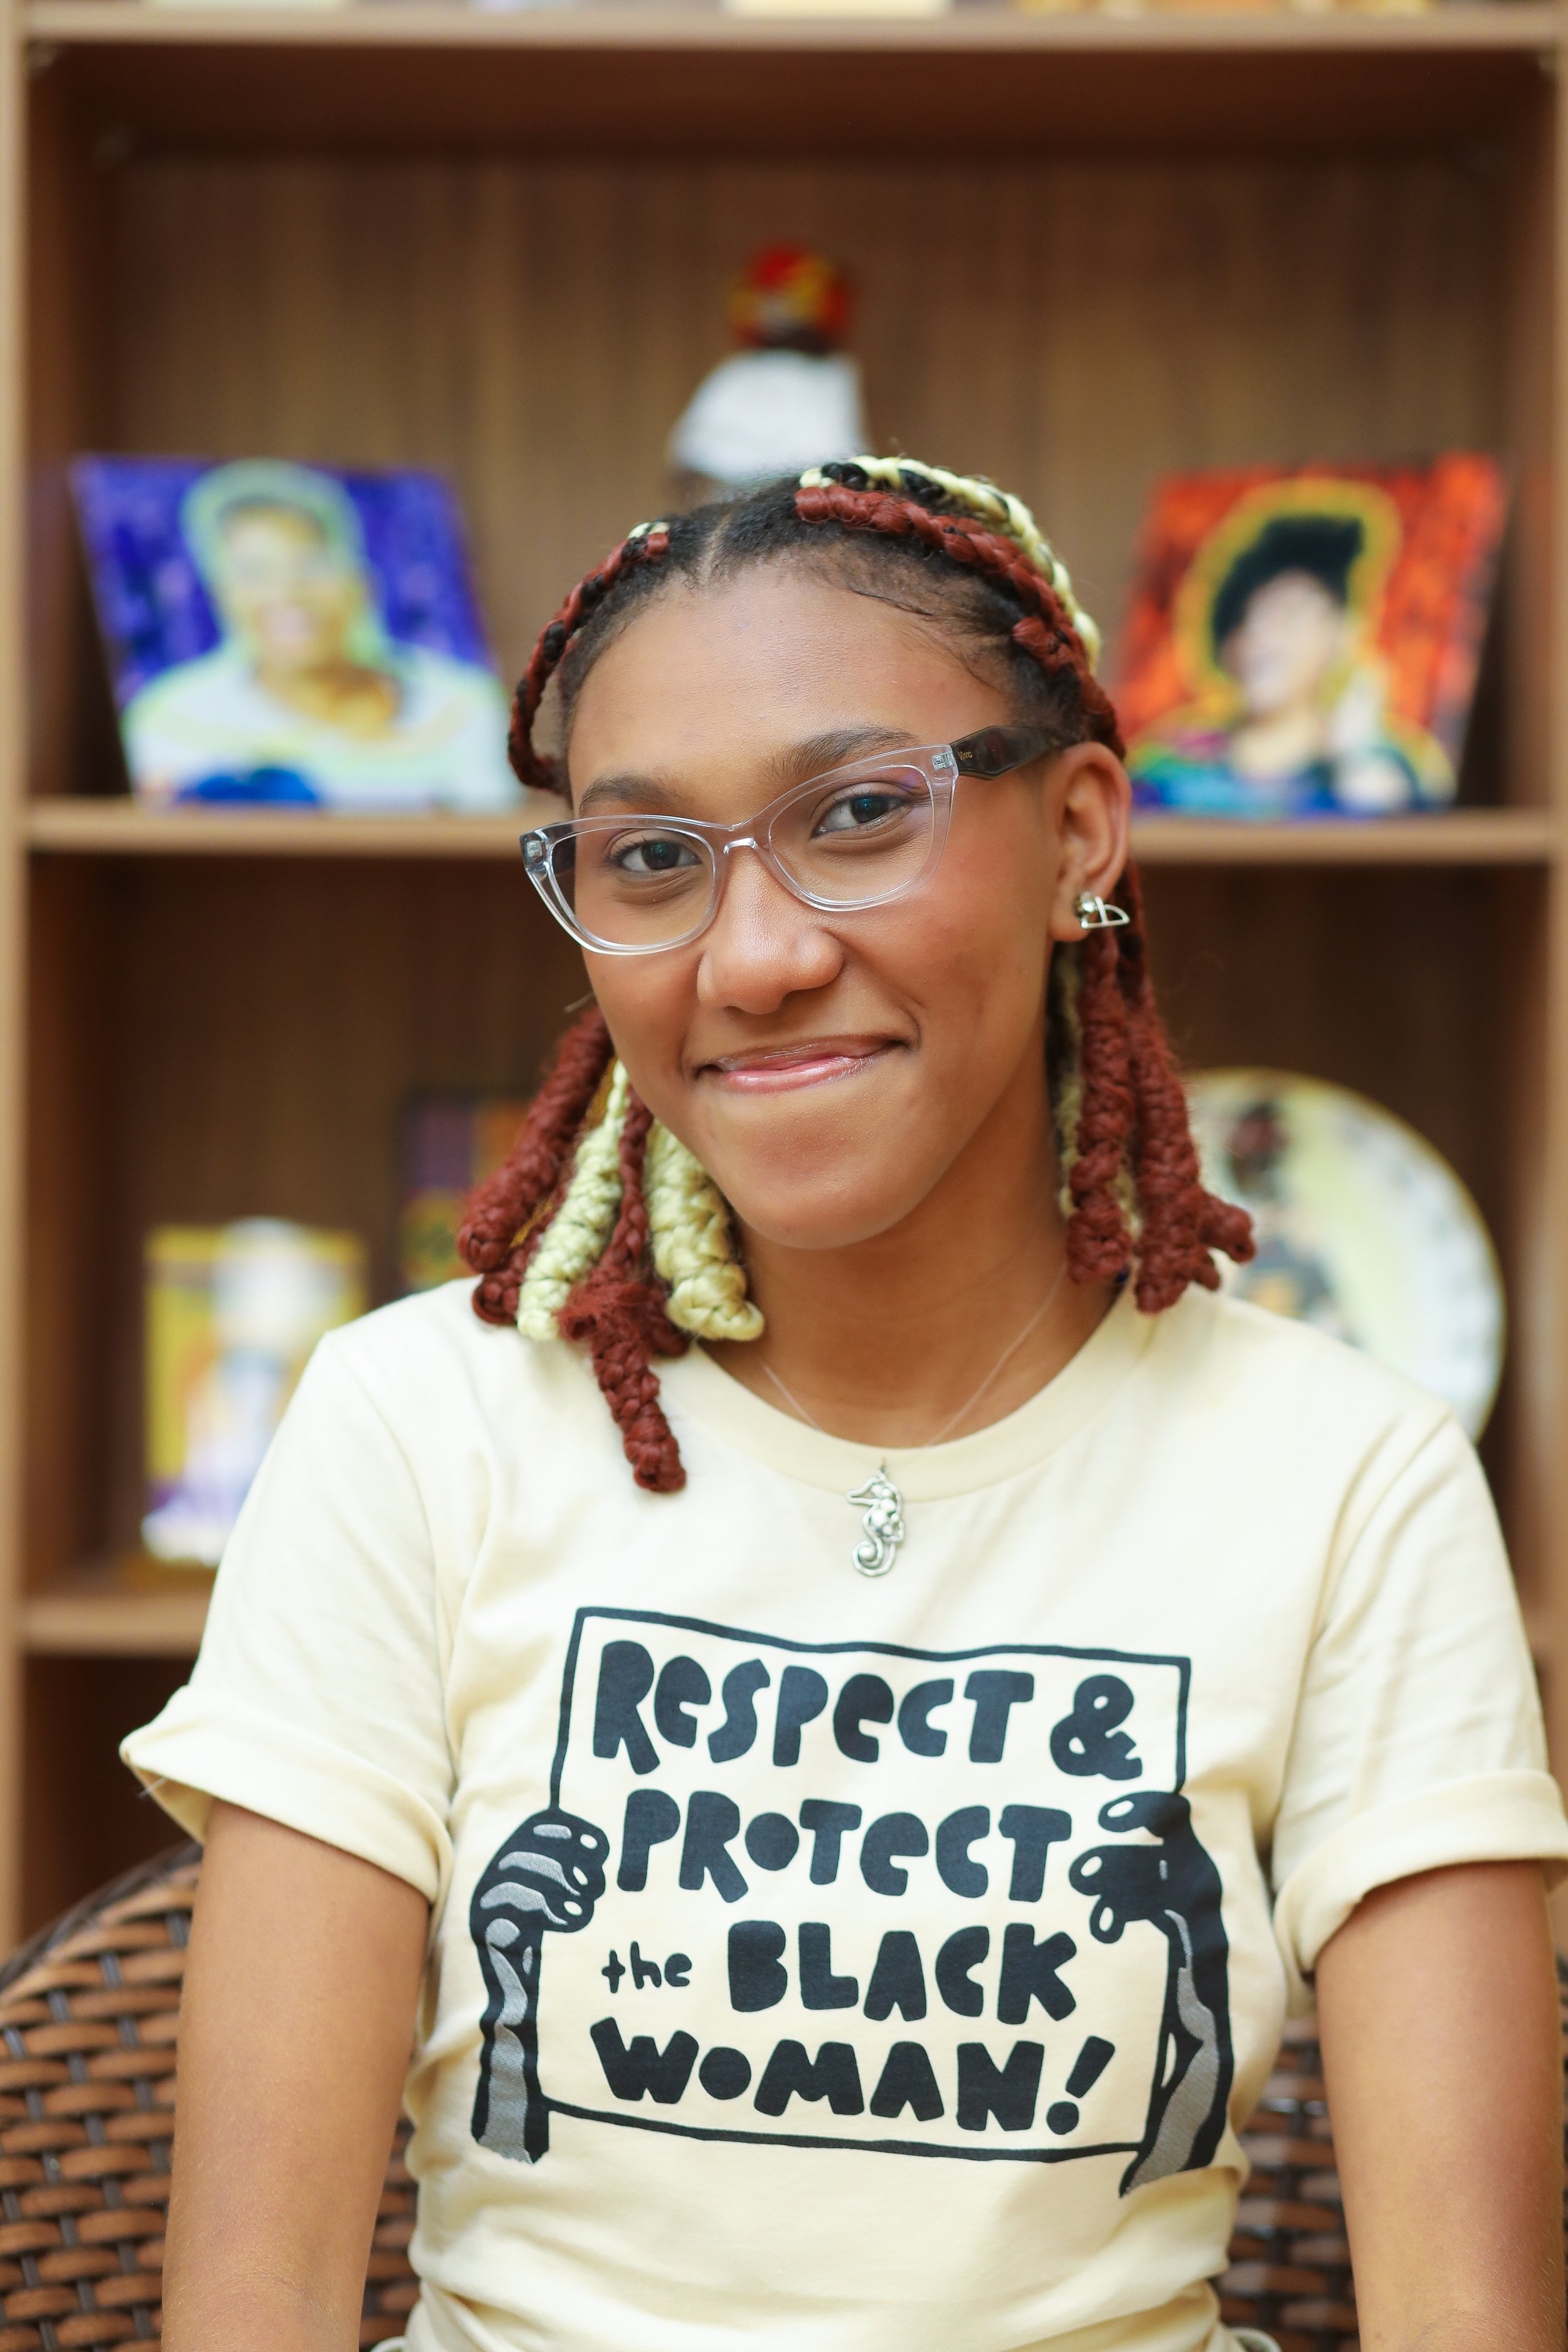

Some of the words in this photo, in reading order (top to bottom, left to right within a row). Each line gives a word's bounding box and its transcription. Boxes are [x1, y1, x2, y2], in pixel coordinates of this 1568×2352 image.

[1051, 1675, 1142, 1780] &
[602, 1942, 692, 1993] the
[728, 1921, 1076, 2025] BLACK
